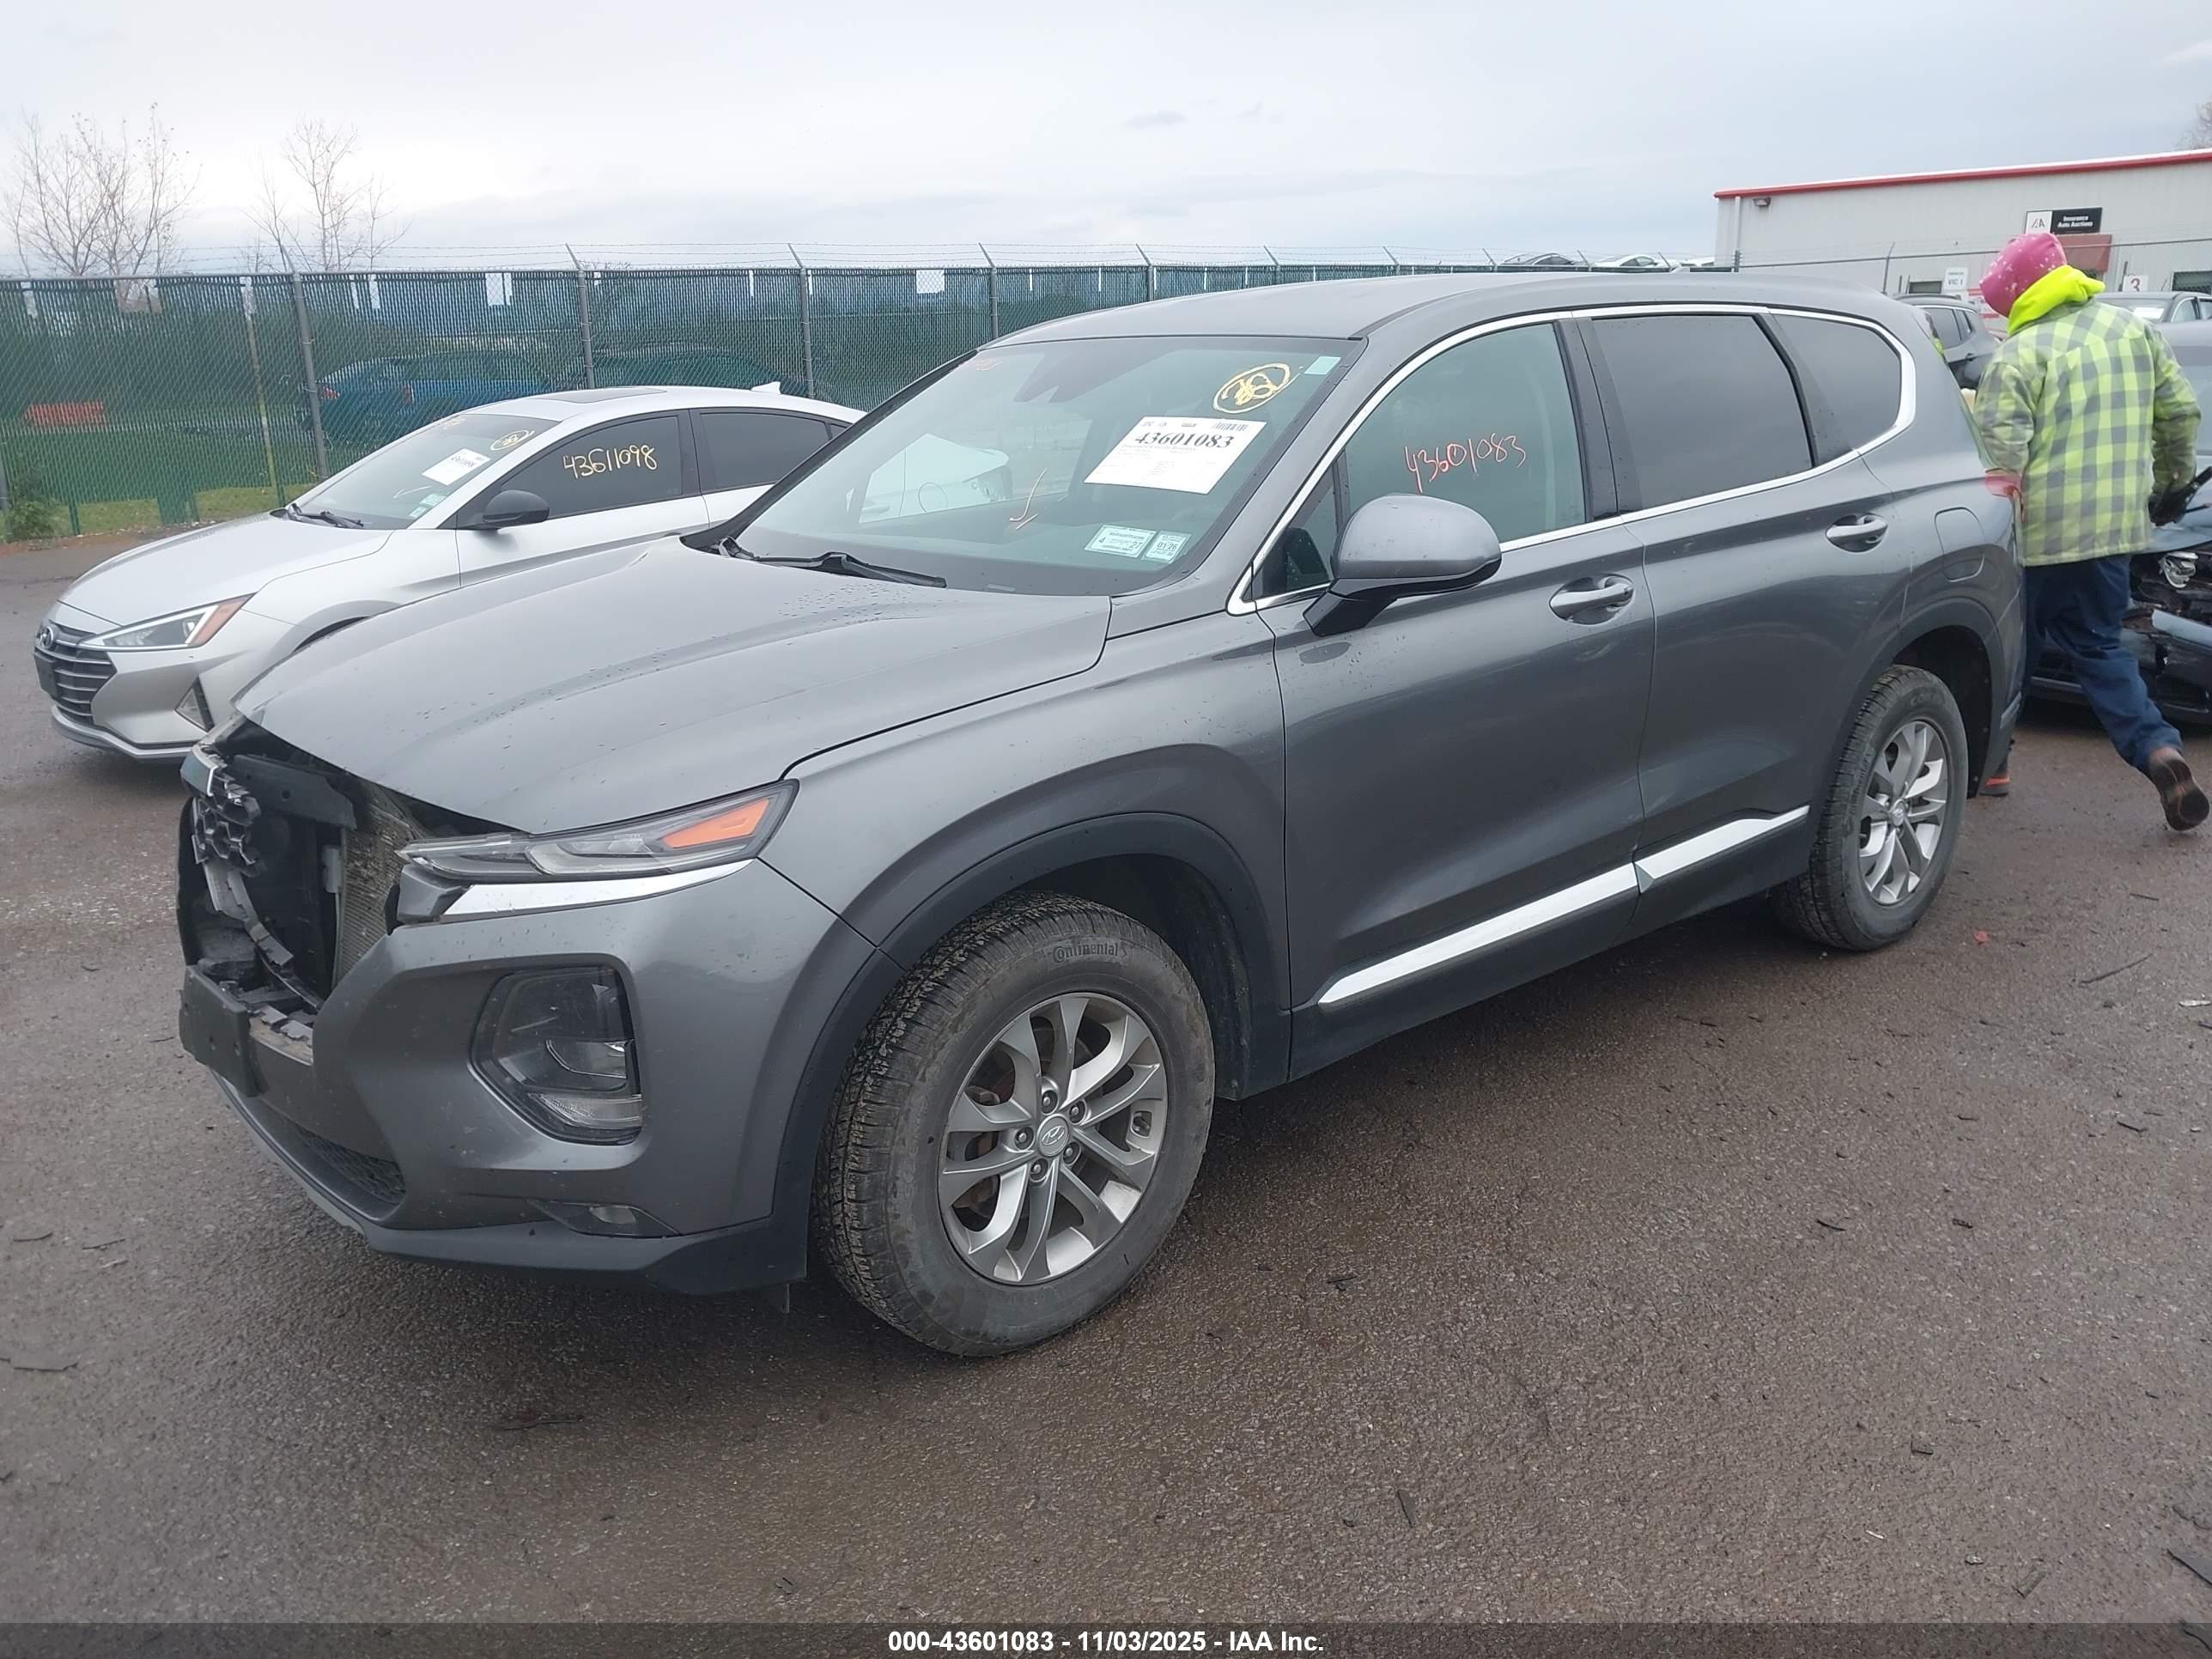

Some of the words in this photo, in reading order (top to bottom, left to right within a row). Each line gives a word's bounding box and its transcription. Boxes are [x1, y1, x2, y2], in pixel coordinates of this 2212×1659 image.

[1134, 432, 1235, 448] 43601083
[563, 445, 657, 479] 43611098
[1405, 433, 1526, 494] 43601083
